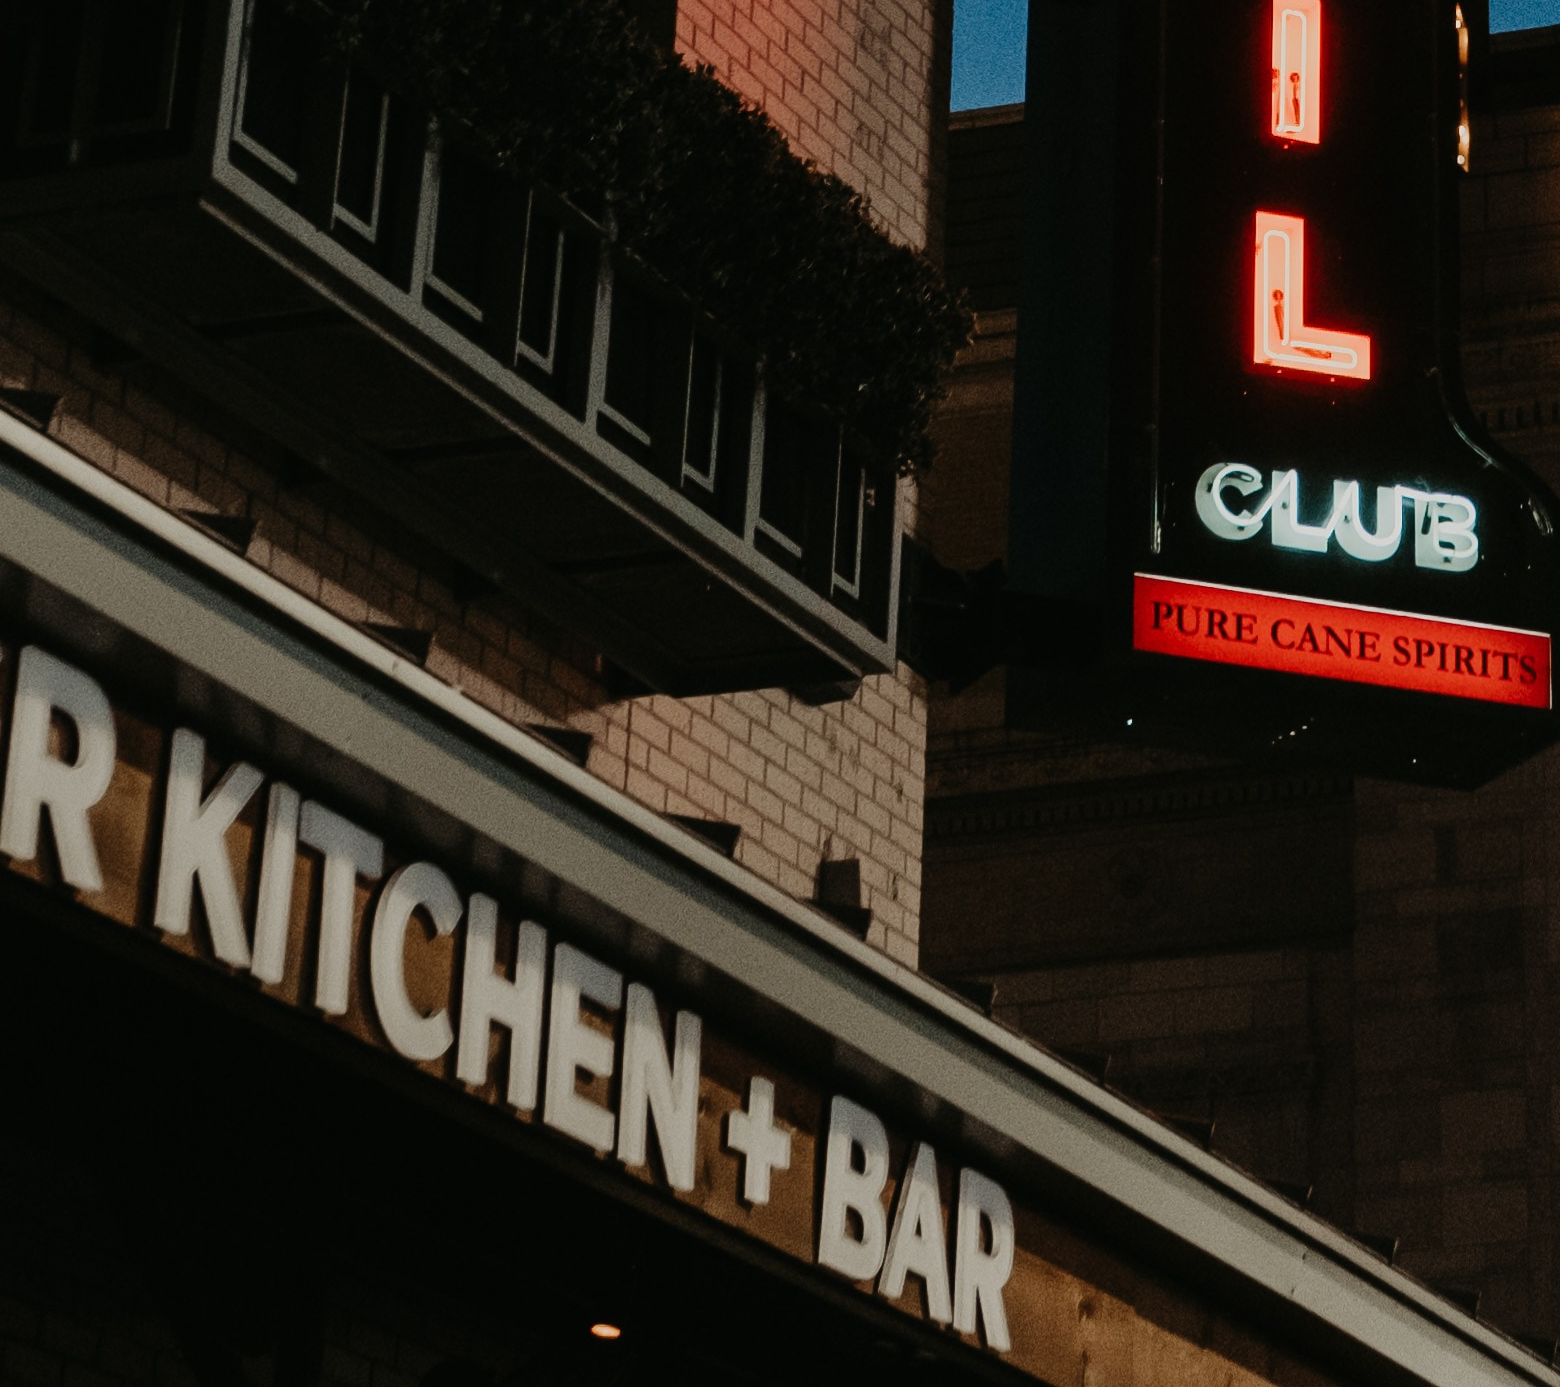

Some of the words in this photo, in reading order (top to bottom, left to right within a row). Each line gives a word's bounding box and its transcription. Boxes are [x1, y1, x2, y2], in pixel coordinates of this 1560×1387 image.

[1195, 462, 1479, 572] CLUB
[1151, 600, 1259, 644] PURE
[1270, 618, 1381, 663] CANE
[1393, 635, 1539, 686] SPIRITS
[154, 727, 702, 1193] KITCHEN
[818, 1094, 1016, 1354] BAR
